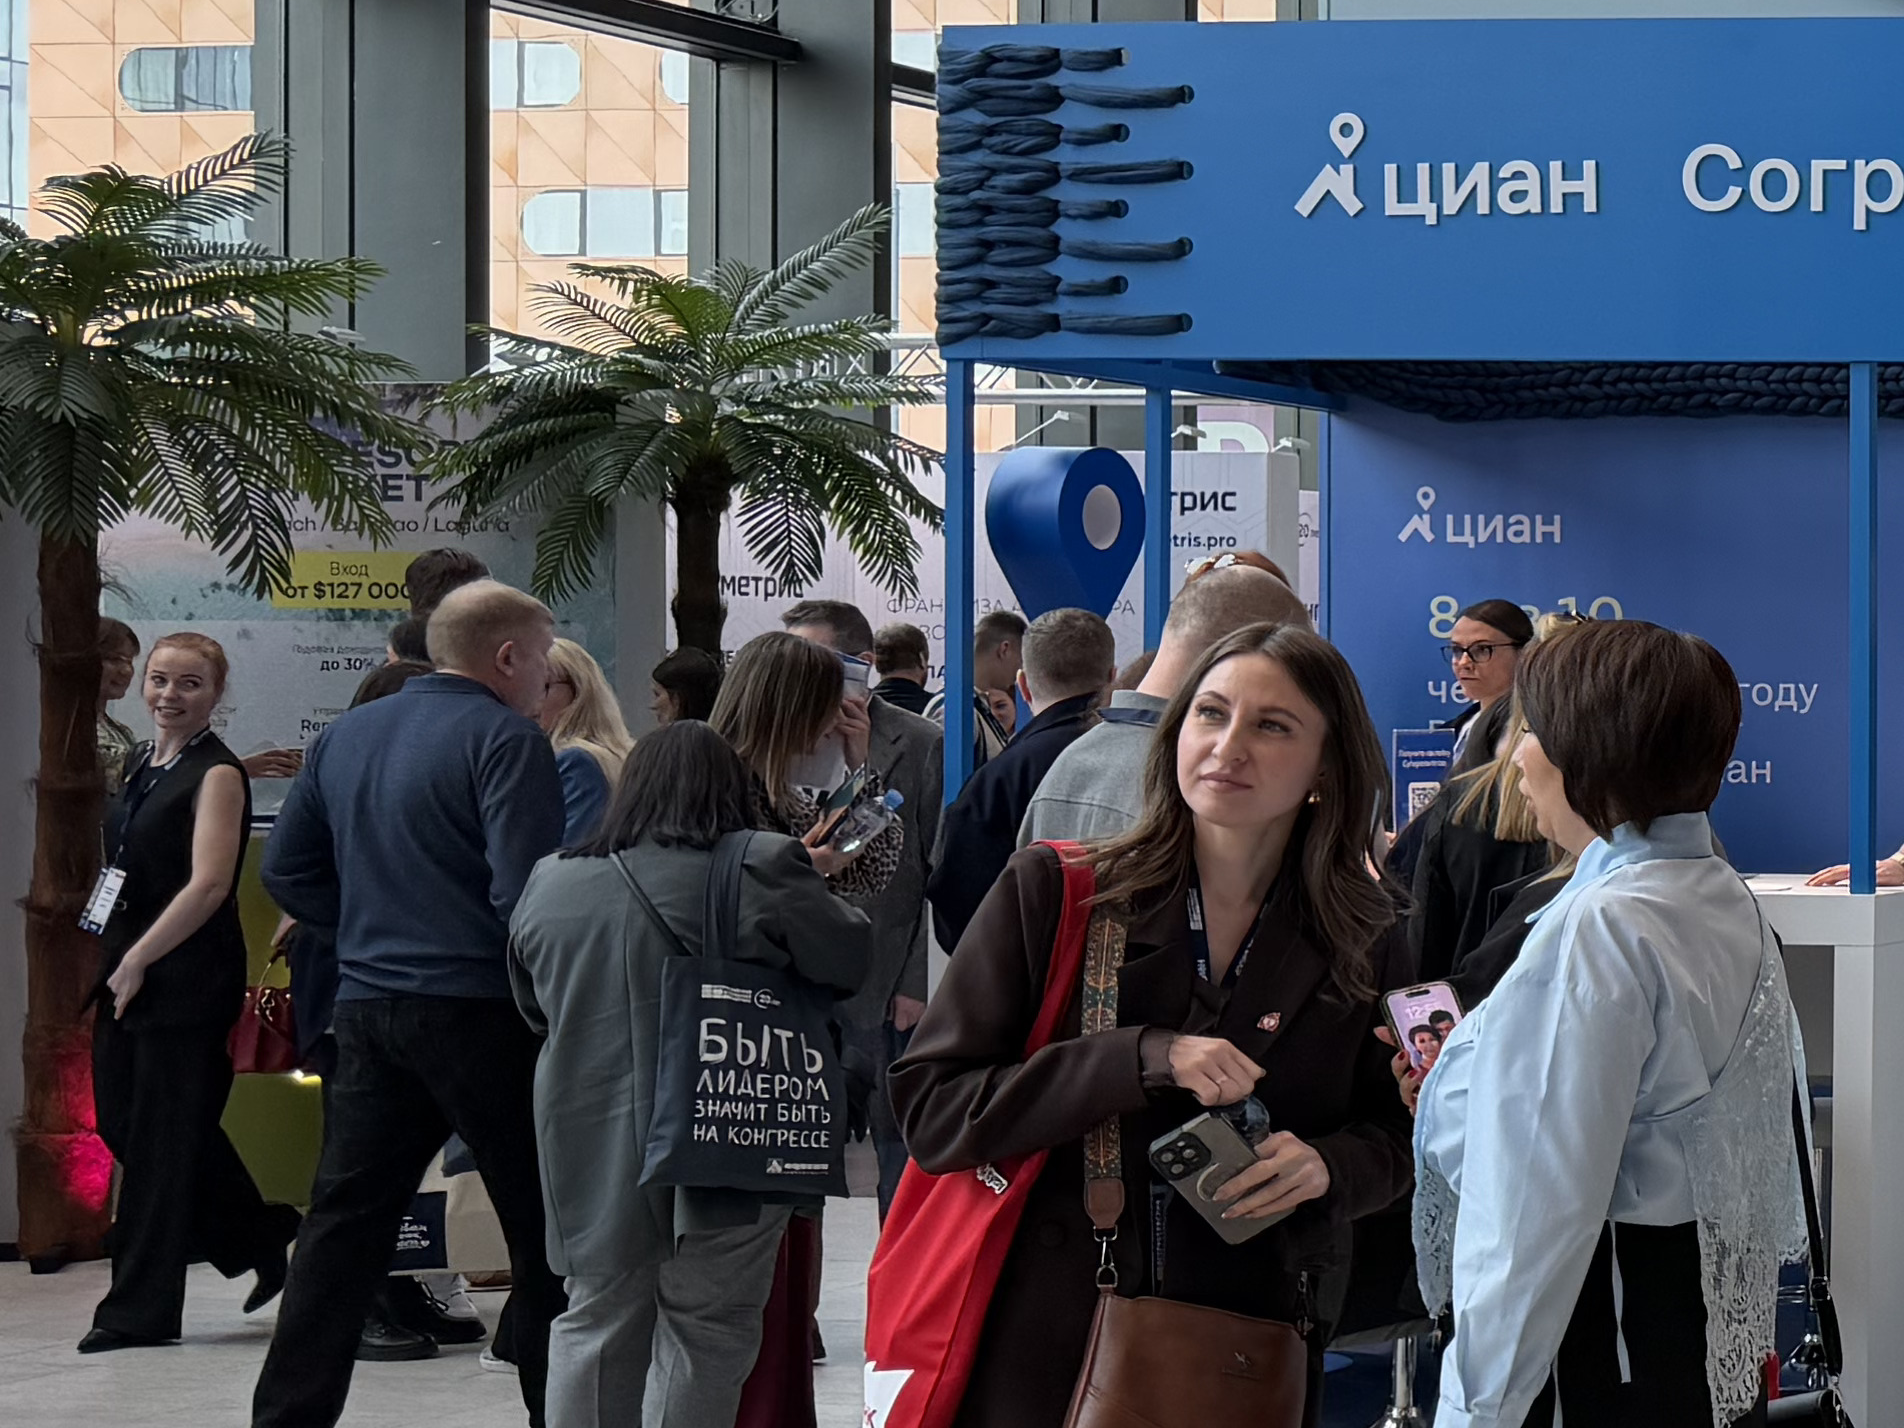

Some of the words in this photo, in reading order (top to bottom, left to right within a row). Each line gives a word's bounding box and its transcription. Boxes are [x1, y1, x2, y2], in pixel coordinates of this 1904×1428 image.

[1384, 158, 1598, 225] циан
[1172, 490, 1237, 516] рис
[1172, 532, 1238, 551] tris.pro
[1446, 513, 1561, 548] циан
[330, 561, 369, 578] Вход
[285, 585, 309, 599] от
[313, 580, 363, 600] $127
[320, 659, 340, 672] до
[1727, 759, 1771, 784] ан
[699, 1018, 823, 1073] БЫТЬ
[696, 1068, 830, 1102] ЛИДЕРОМ
[694, 1099, 768, 1122] ЗНАЧИТ
[777, 1103, 831, 1124] БЫТЬ
[693, 1123, 719, 1144] НА
[728, 1126, 831, 1148] КОНГРЕССЕ
